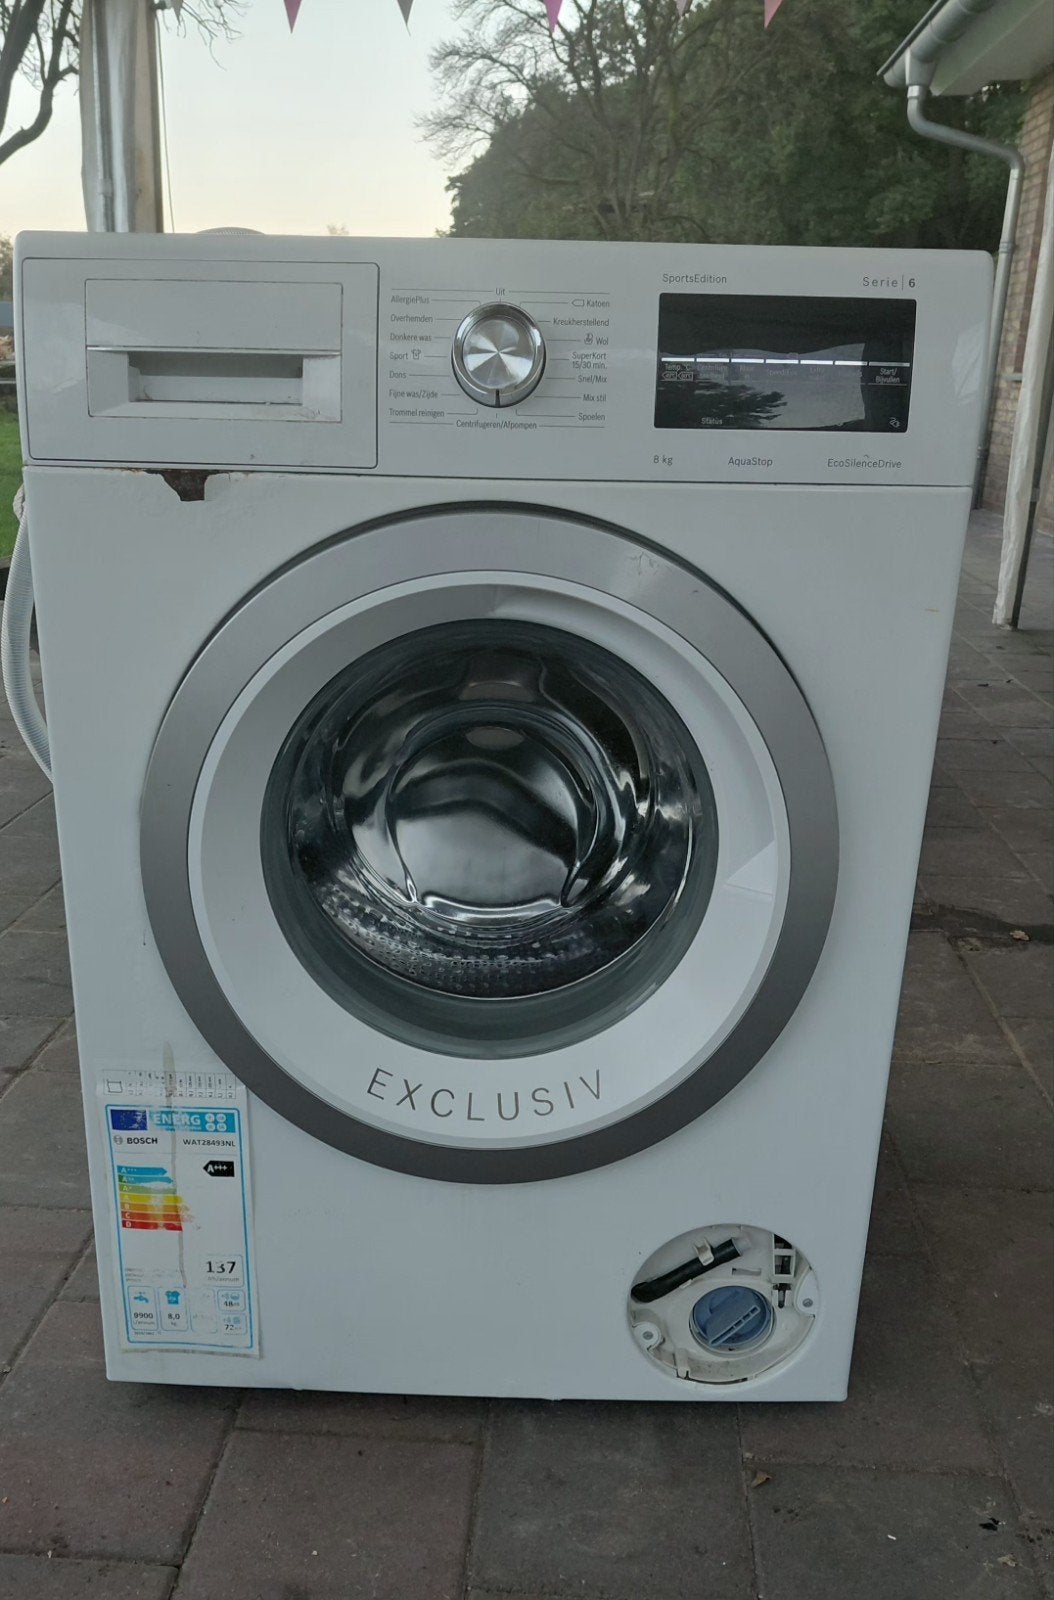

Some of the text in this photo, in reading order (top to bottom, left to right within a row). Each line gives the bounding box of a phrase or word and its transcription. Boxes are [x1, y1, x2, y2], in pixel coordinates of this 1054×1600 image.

[662, 273, 727, 284] SportsEdition
[862, 276, 916, 288] Serie 6
[495, 287, 505, 296] Uit
[390, 295, 430, 305] AllergiePlus
[586, 299, 610, 308] Katoen
[390, 314, 433, 323] Overhemden
[553, 318, 609, 327] Kreukherstellend
[390, 333, 419, 341] Donkere
[596, 337, 608, 345] Wol
[389, 349, 408, 360] Sport
[572, 351, 607, 361] SuperKort
[572, 361, 591, 369] 15/30
[389, 370, 407, 379] Dons
[577, 375, 607, 384] Snel/Mix
[389, 389, 438, 399] Fijne was/Zijde
[596, 394, 606, 402] stil
[389, 408, 444, 418] Trommel reinigen
[578, 412, 605, 421] Spoelen
[456, 420, 537, 430] Centrifugeren/Afpompen
[701, 417, 723, 425] Status
[653, 455, 673, 466] 8 kg
[728, 456, 773, 467] AquaStop
[827, 457, 902, 469] EcoSilenceDrive
[367, 1067, 600, 1121] EXCLUSIV
[153, 1112, 202, 1126] ENERG
[126, 1137, 158, 1145] BOSCH
[183, 1138, 236, 1147] WAT28493NL
[207, 1163, 228, 1173] A+++
[206, 1261, 236, 1274] 137
